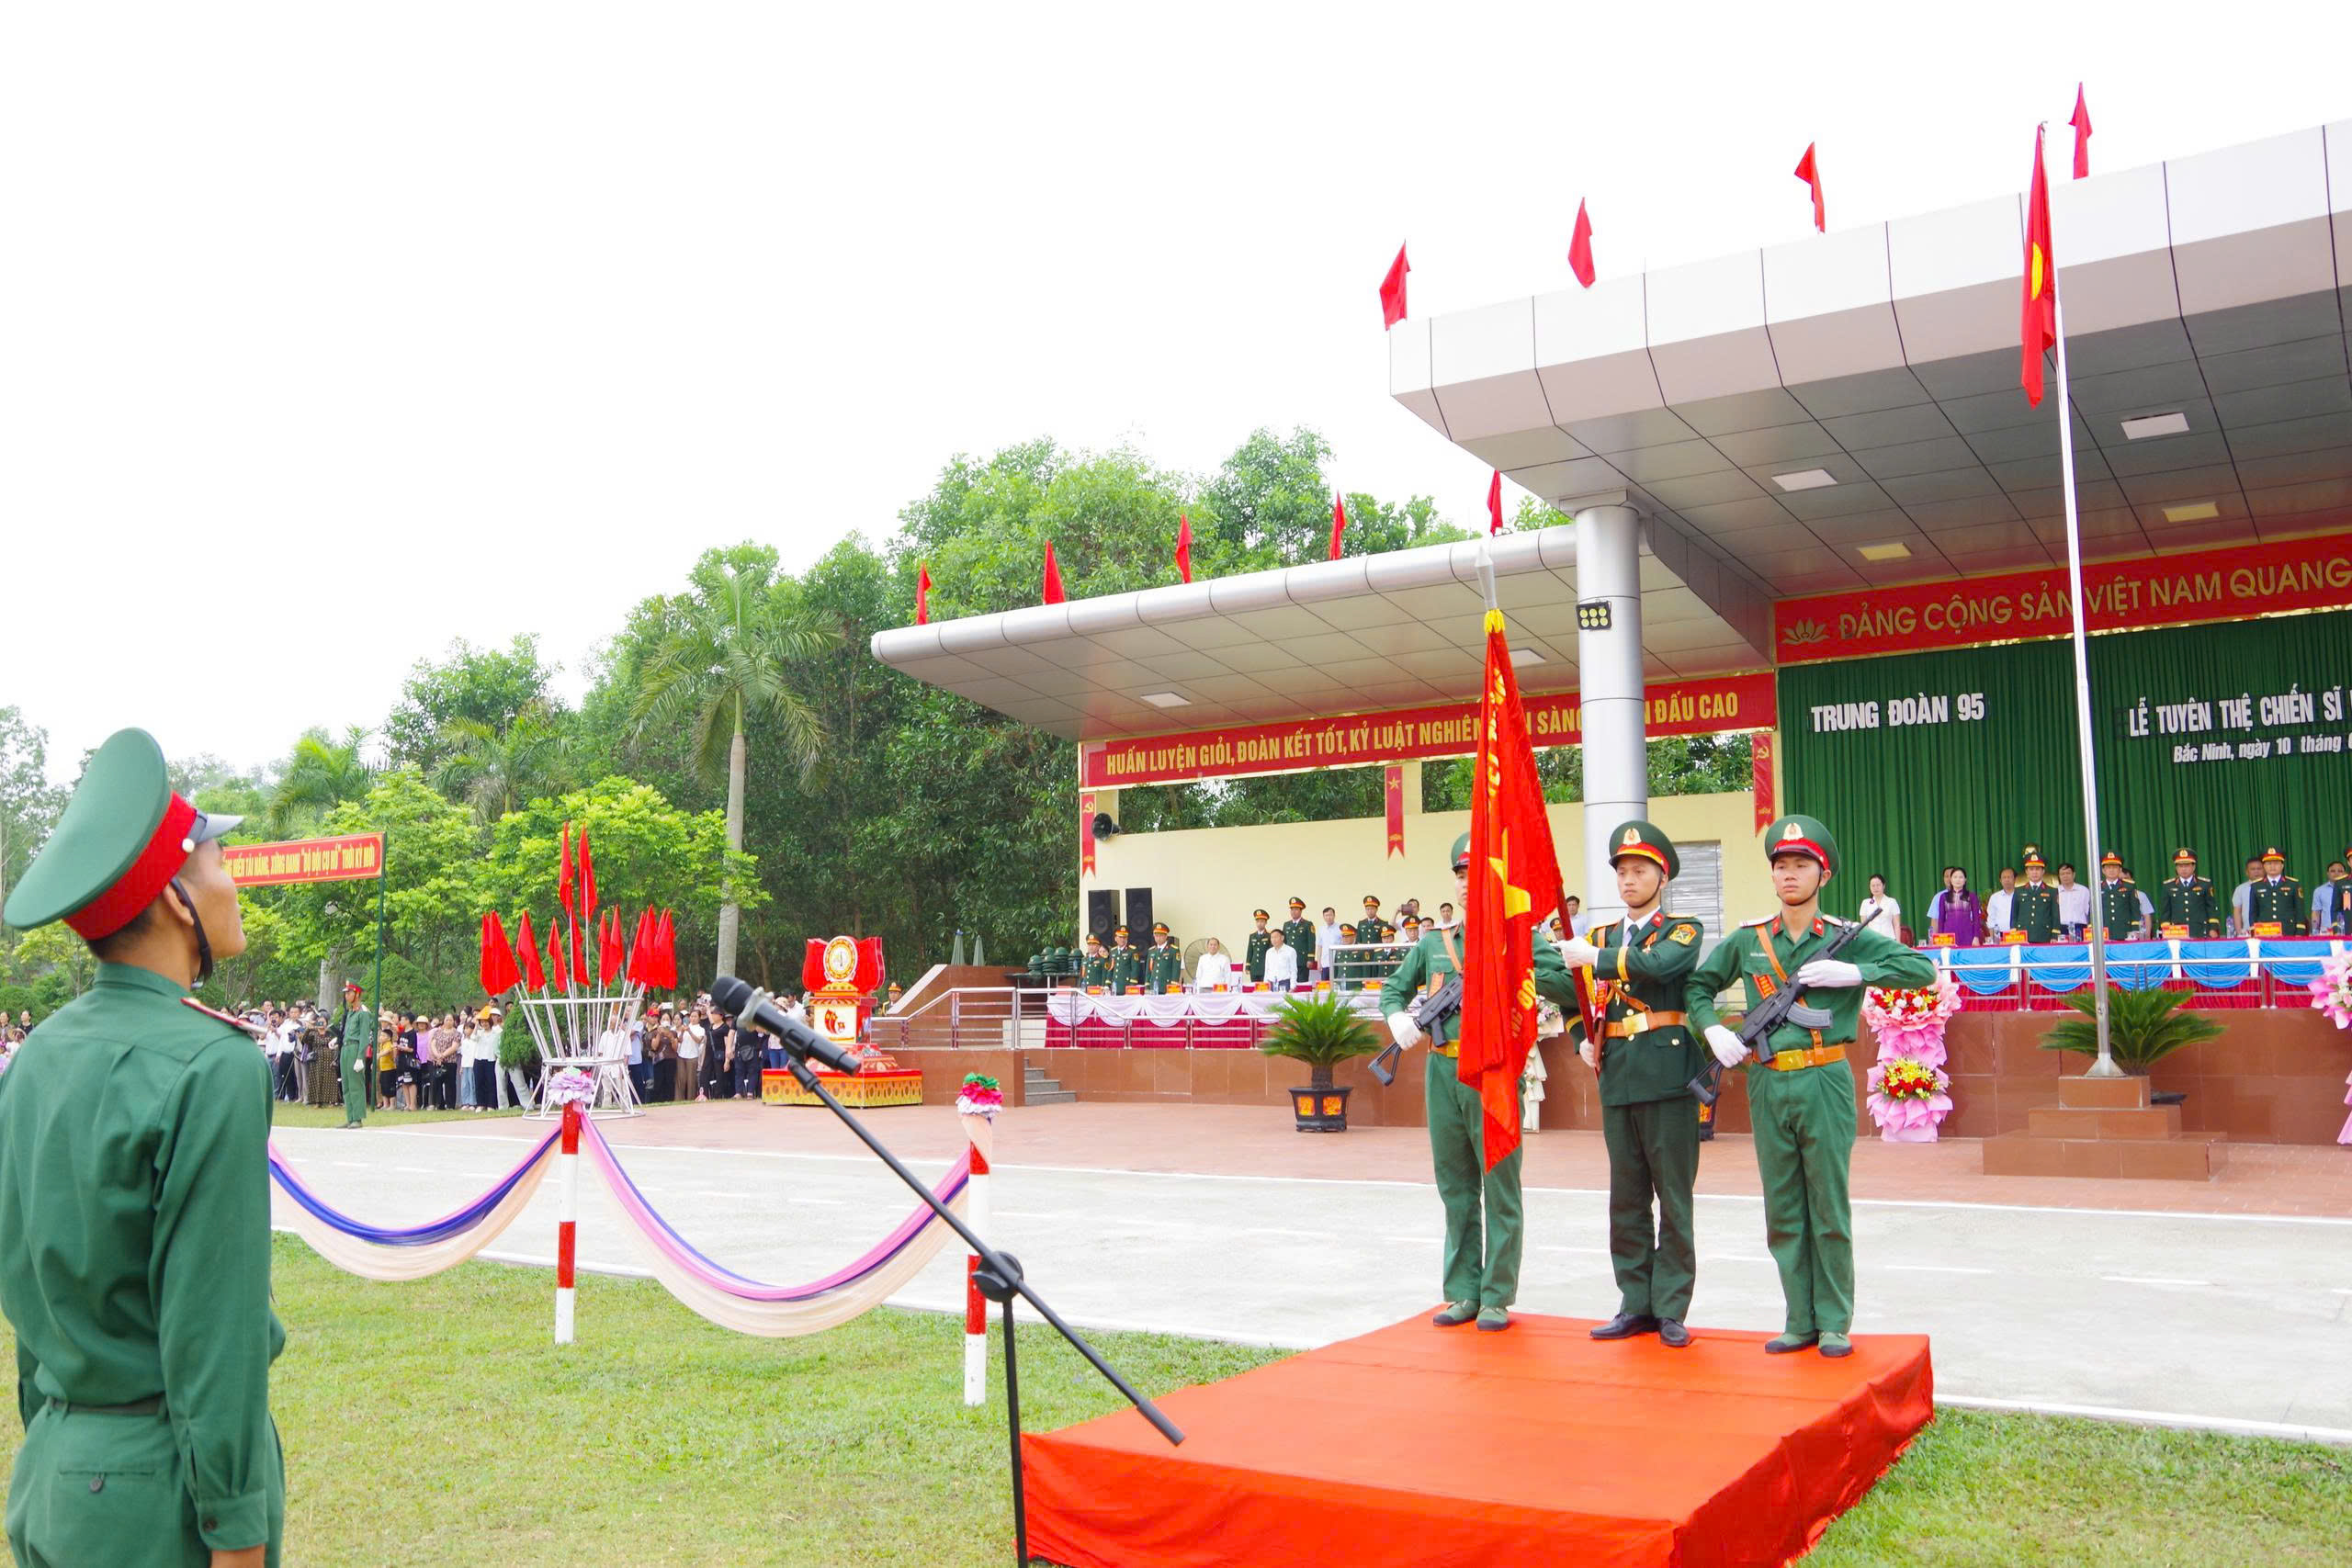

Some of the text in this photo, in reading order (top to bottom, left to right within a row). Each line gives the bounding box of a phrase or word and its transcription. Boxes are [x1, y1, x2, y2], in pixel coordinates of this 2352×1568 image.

[1840, 558, 2352, 639] ĐẢNG CỘNG SẢN VIỆT NAM QUANG
[1106, 745, 1146, 775] HUẤN
[1149, 745, 1196, 772] LUYỆN
[1200, 736, 1235, 766] GIỎI,
[1237, 732, 1280, 762] ĐOÀN
[1284, 727, 1312, 758] KẾT
[1316, 724, 1347, 755] TỐT,
[1350, 720, 1369, 750] KỶ
[1374, 720, 1415, 751] LUẬT
[1655, 690, 1694, 724] ĐẤU
[1699, 692, 1738, 719] CAO
[1811, 692, 1984, 733] TRUNG ĐOÀN 95
[2129, 696, 2150, 737] LỄ
[2155, 697, 2211, 734] TUYÊN
[2219, 692, 2254, 732] THỆ
[2260, 682, 2314, 727] CHIẾN
[2323, 685, 2343, 721] SĨ
[2174, 742, 2198, 763] Bắc
[2201, 742, 2234, 761] Ninh,
[2238, 738, 2271, 760] ngày
[2276, 737, 2291, 755] 10
[2300, 733, 2342, 753] tháng
